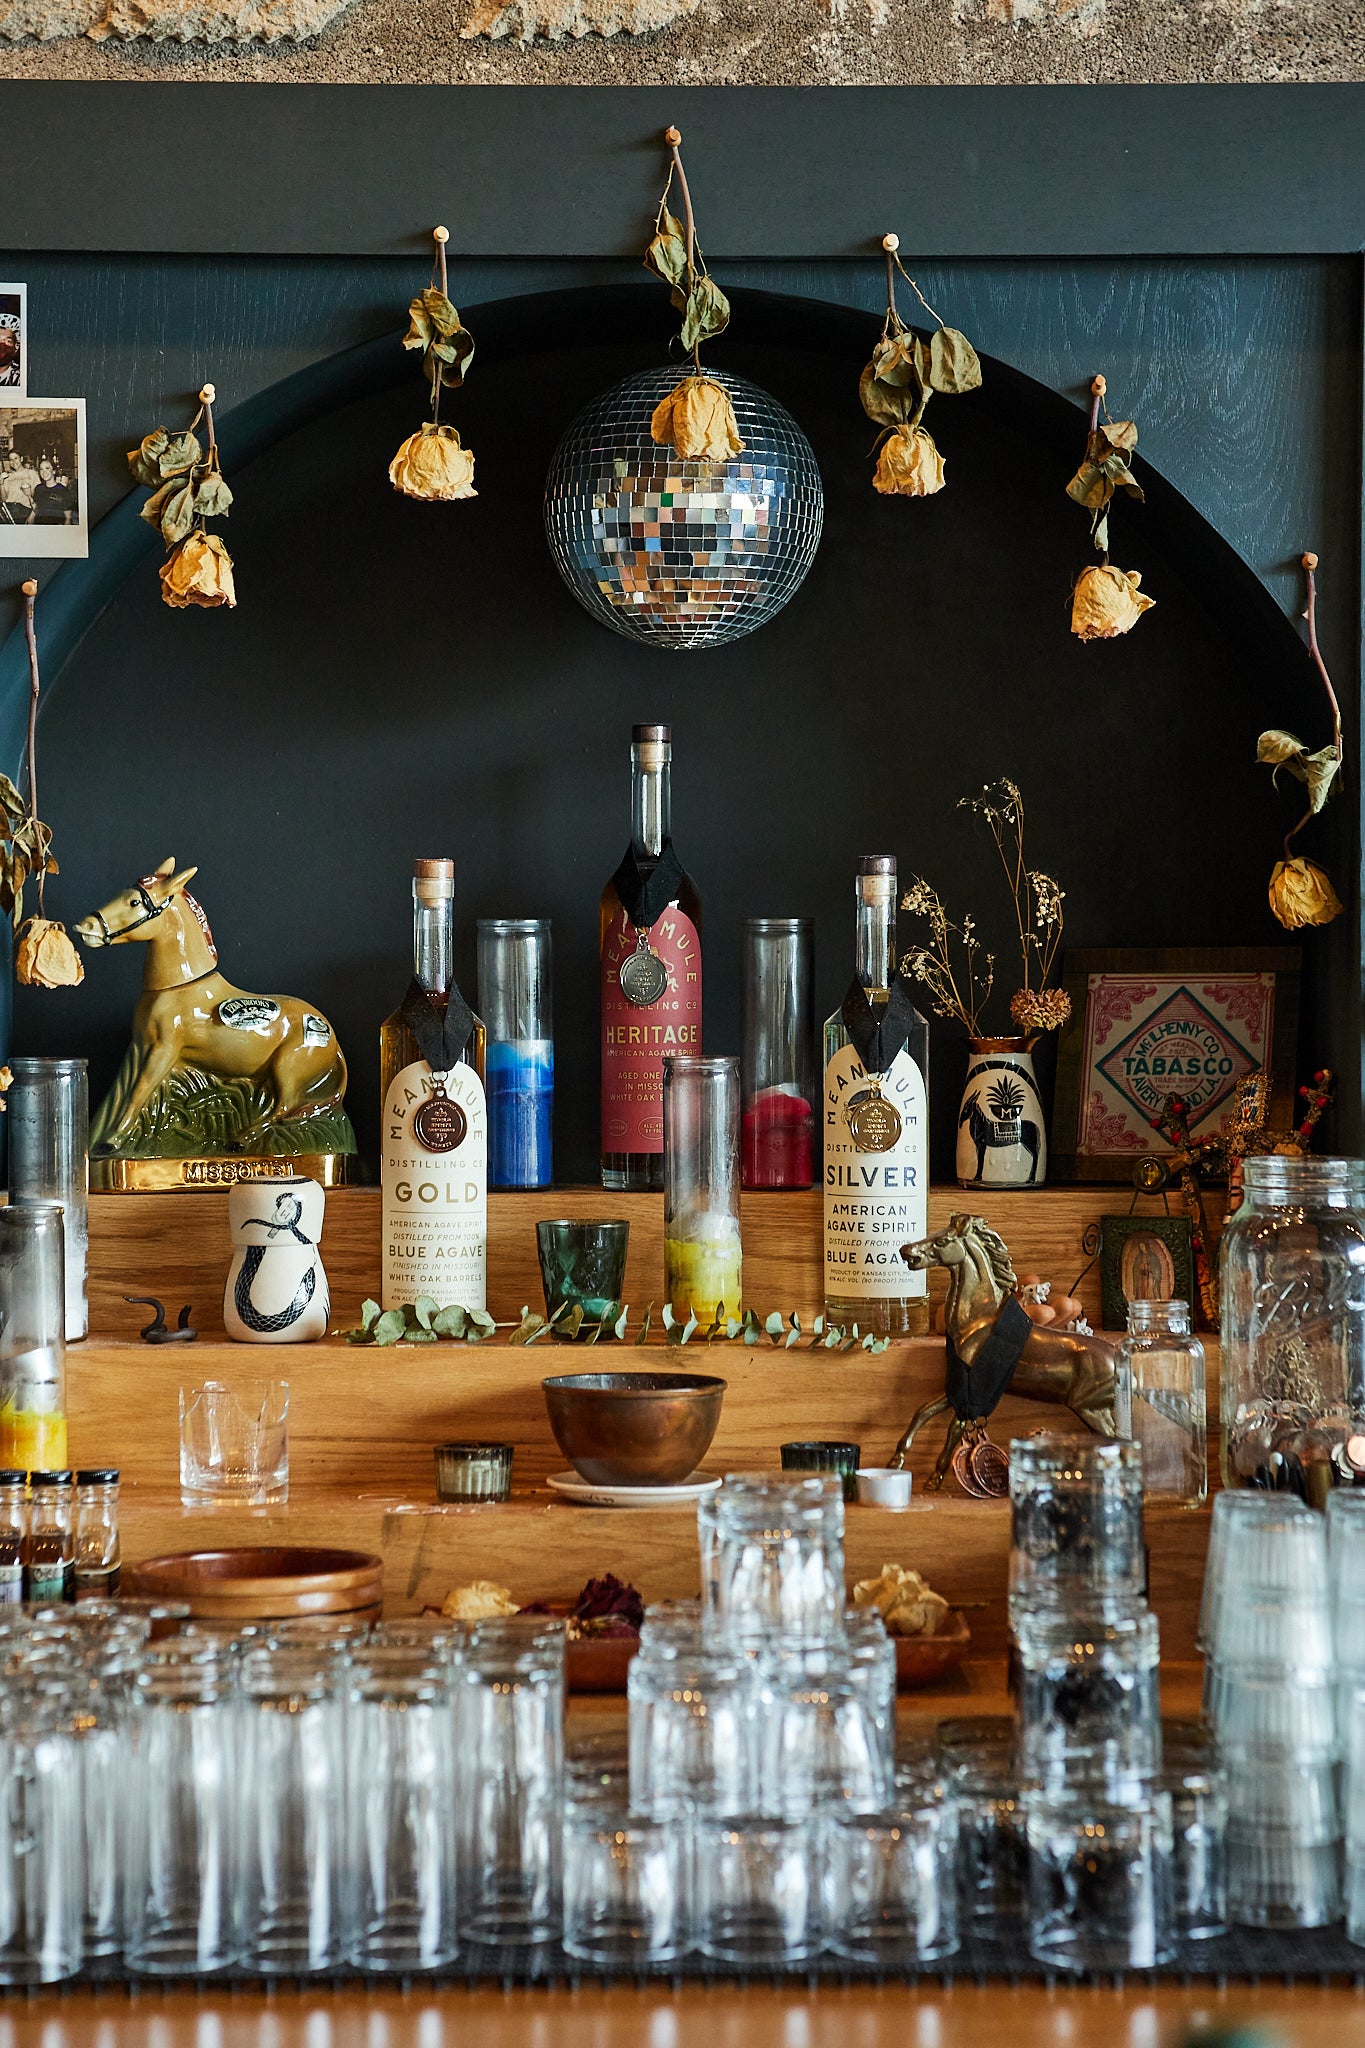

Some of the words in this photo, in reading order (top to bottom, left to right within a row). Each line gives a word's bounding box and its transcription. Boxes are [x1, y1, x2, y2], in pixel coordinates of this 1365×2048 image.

[659, 920, 697, 983] MULE
[606, 1025, 697, 1044] HERITAGE
[1122, 1057, 1234, 1075] TABASCO
[618, 1071, 639, 1079] AGED
[643, 1071, 661, 1079] ONE
[637, 1082, 664, 1091] MISSO
[1132, 1076, 1163, 1108] AVERY
[1200, 1077, 1222, 1097] LA.
[610, 1093, 633, 1101] WHITE
[637, 1093, 656, 1101] OAK
[828, 1062, 865, 1125] MEAN
[390, 1076, 435, 1140] MEAN
[448, 1077, 482, 1140] MULE
[390, 1159, 466, 1168] DISTILLING
[826, 1165, 917, 1187] SILVER
[395, 1181, 479, 1203] GOLD
[832, 1203, 907, 1216] AMERICAN
[389, 1220, 430, 1228] AMERICAN
[827, 1219, 866, 1232] AGAVE
[871, 1222, 917, 1233] SPIRIT
[393, 1232, 435, 1241] DISTILLED
[437, 1233, 463, 1241] FROM
[829, 1237, 862, 1247] DISTILLED
[864, 1239, 890, 1247] FROM
[389, 1245, 427, 1258] BLUE
[435, 1245, 482, 1258] AGAVE
[827, 1250, 857, 1264] BLUE
[864, 1252, 908, 1265] AGA
[392, 1261, 430, 1270] FINISHED
[431, 1262, 441, 1270] IN
[443, 1262, 480, 1270] MISSOURI
[830, 1268, 851, 1276] PRODUCT
[389, 1273, 416, 1282] WHITE
[419, 1275, 442, 1283] OAK
[445, 1274, 482, 1282] BARRELS
[394, 1287, 420, 1295] PRODUCT
